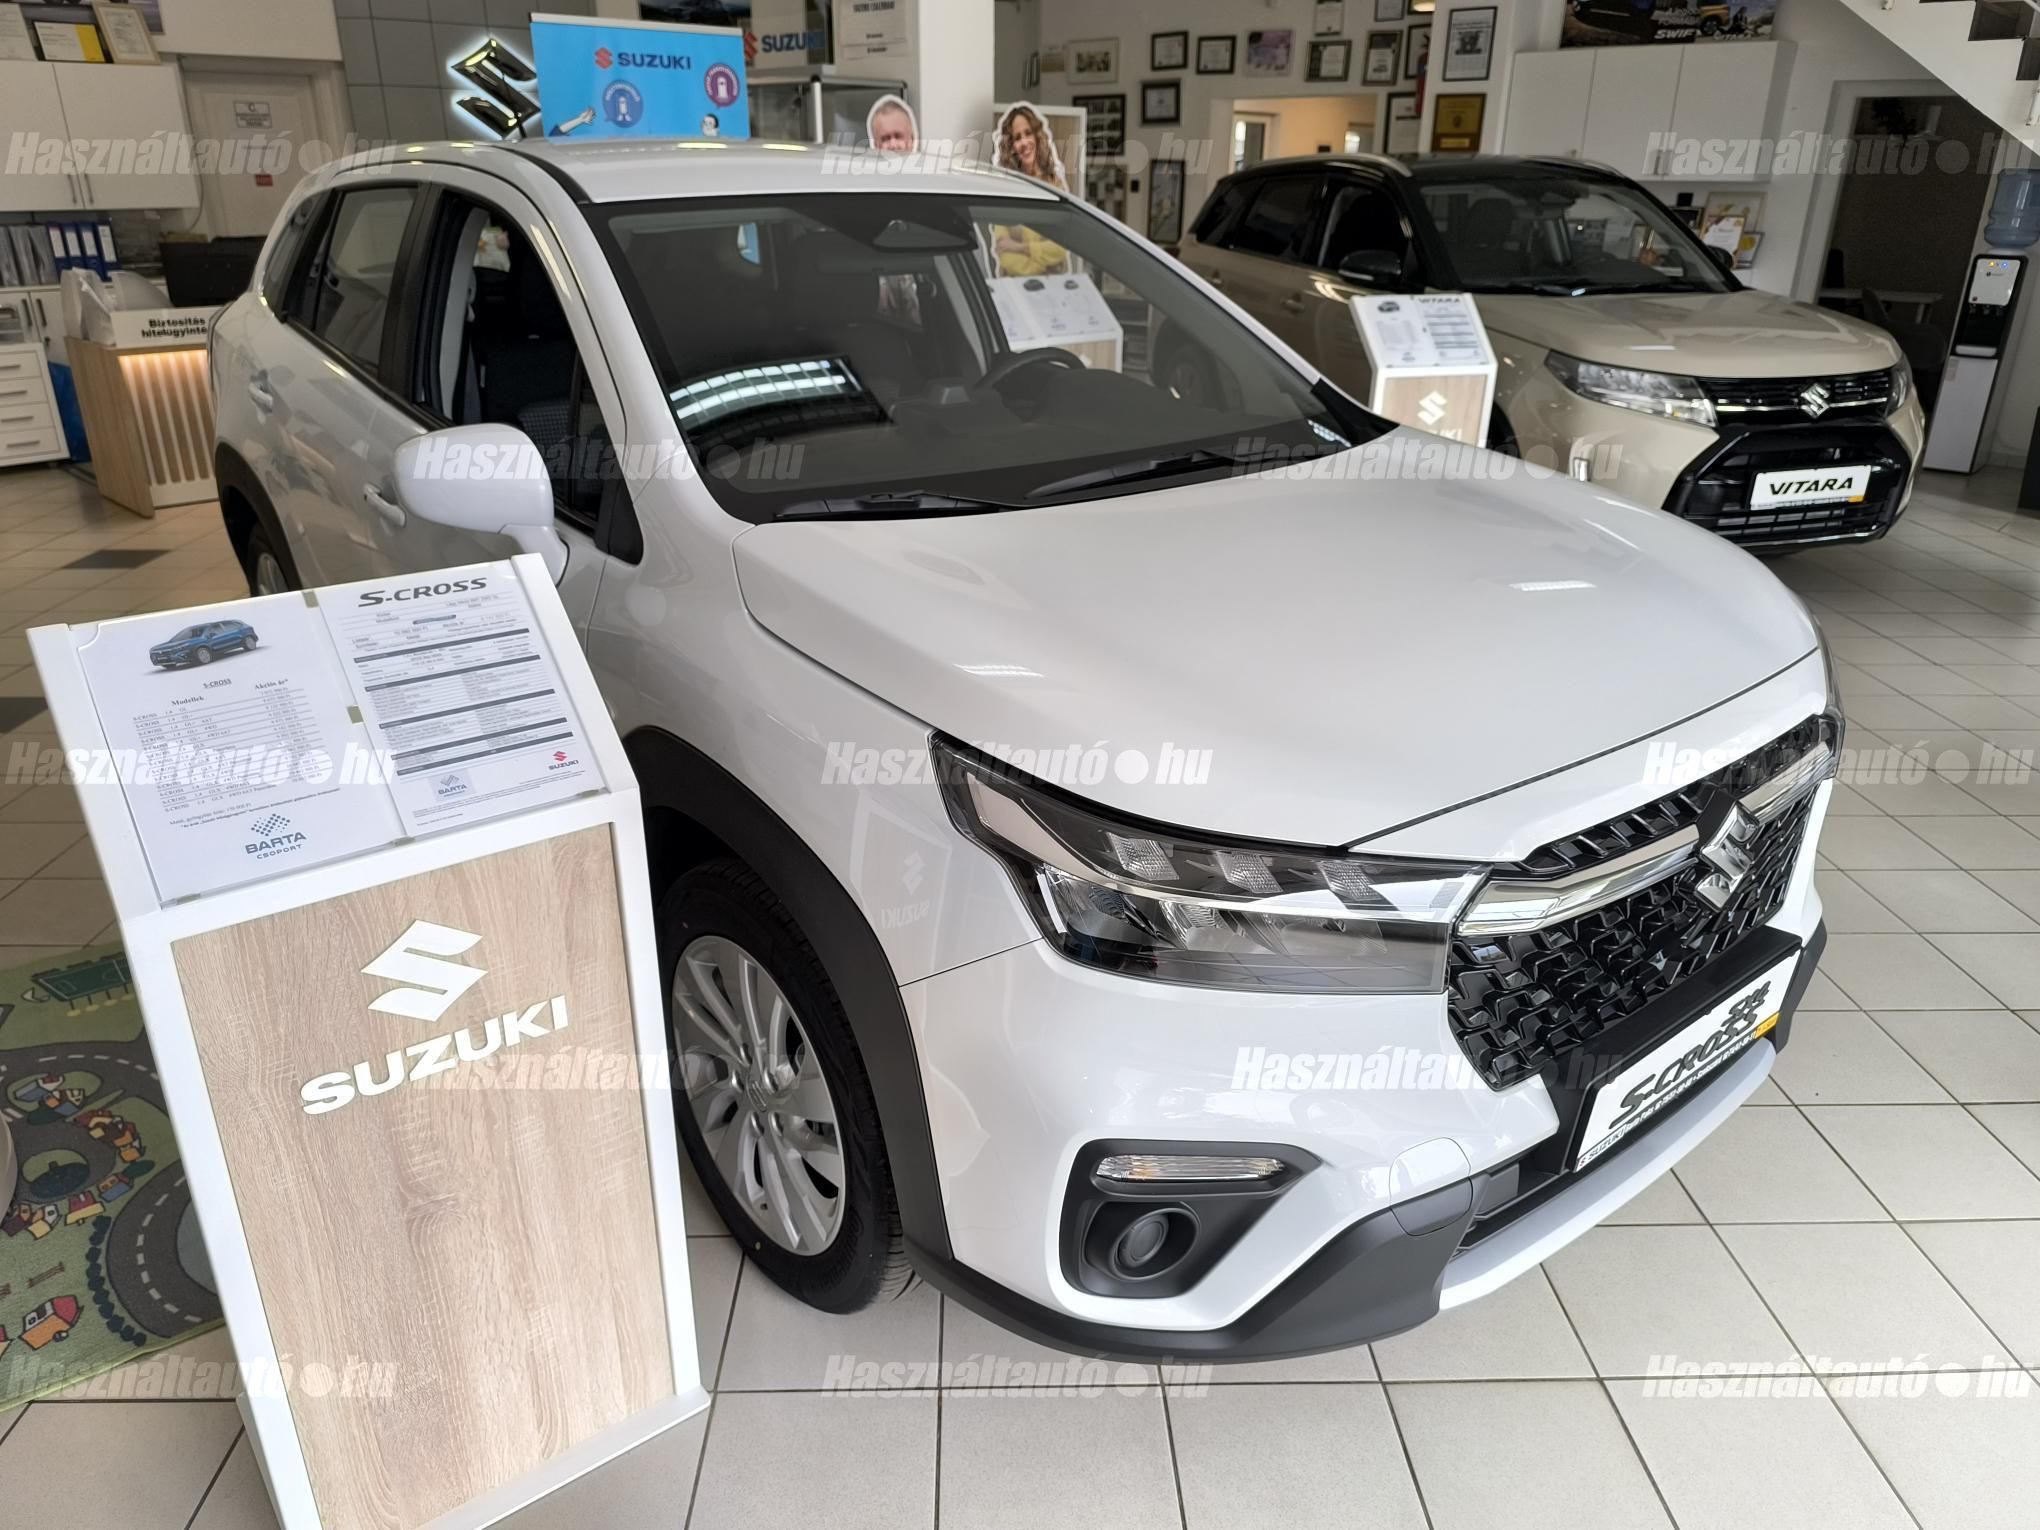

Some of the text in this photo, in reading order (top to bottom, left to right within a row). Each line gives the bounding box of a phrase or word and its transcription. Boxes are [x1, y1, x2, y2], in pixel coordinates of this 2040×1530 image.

[617, 52, 691, 70] SUZUKI
[141, 326, 207, 338] hitelügyinté
[1770, 477, 1853, 495] VITARA
[358, 577, 487, 607] S-CROSS
[203, 678, 232, 689] S-CROSS
[171, 696, 204, 706] Modellek
[548, 760, 579, 770] SUZUKI
[438, 784, 467, 795] BARTA
[245, 831, 307, 855] BARTA
[256, 843, 303, 860] CSOPORT
[301, 995, 569, 1115] SUZUKI
